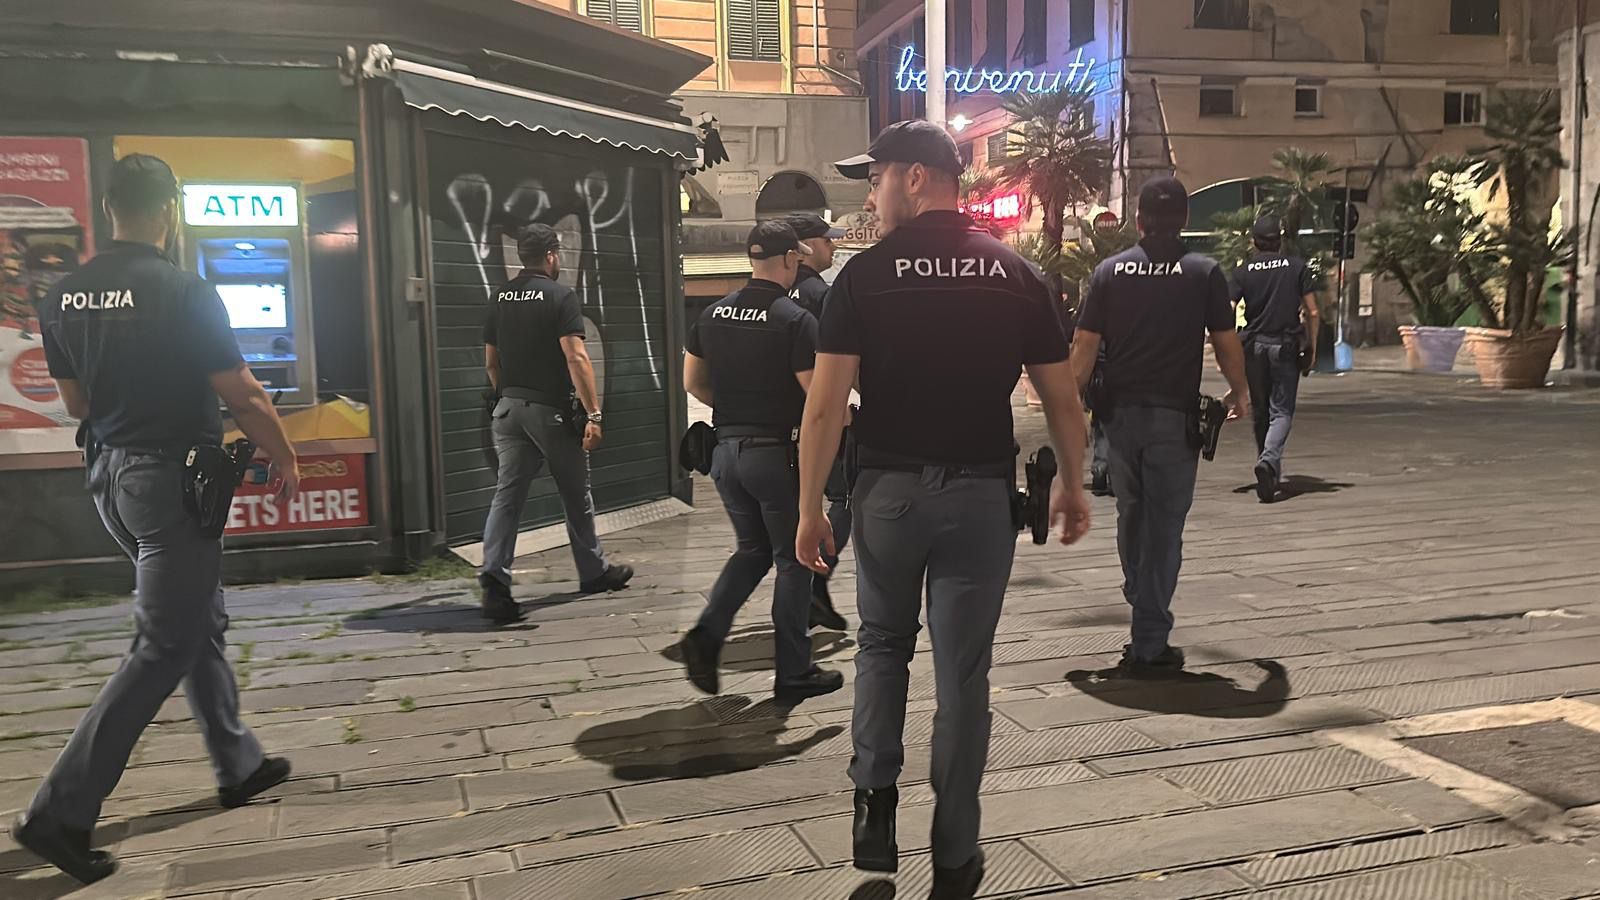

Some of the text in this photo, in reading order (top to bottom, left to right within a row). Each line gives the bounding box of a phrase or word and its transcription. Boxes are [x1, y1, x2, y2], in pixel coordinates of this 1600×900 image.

[204, 195, 283, 216] ATM
[895, 257, 1007, 278] POLIZIA
[1114, 261, 1183, 276] POLIZIA
[1247, 259, 1289, 272] POLIZIA
[61, 289, 134, 312] POLIZIA
[498, 290, 544, 302] POLIZIA
[712, 306, 767, 322] POLIZIA
[224, 488, 361, 528] ETS HERE
